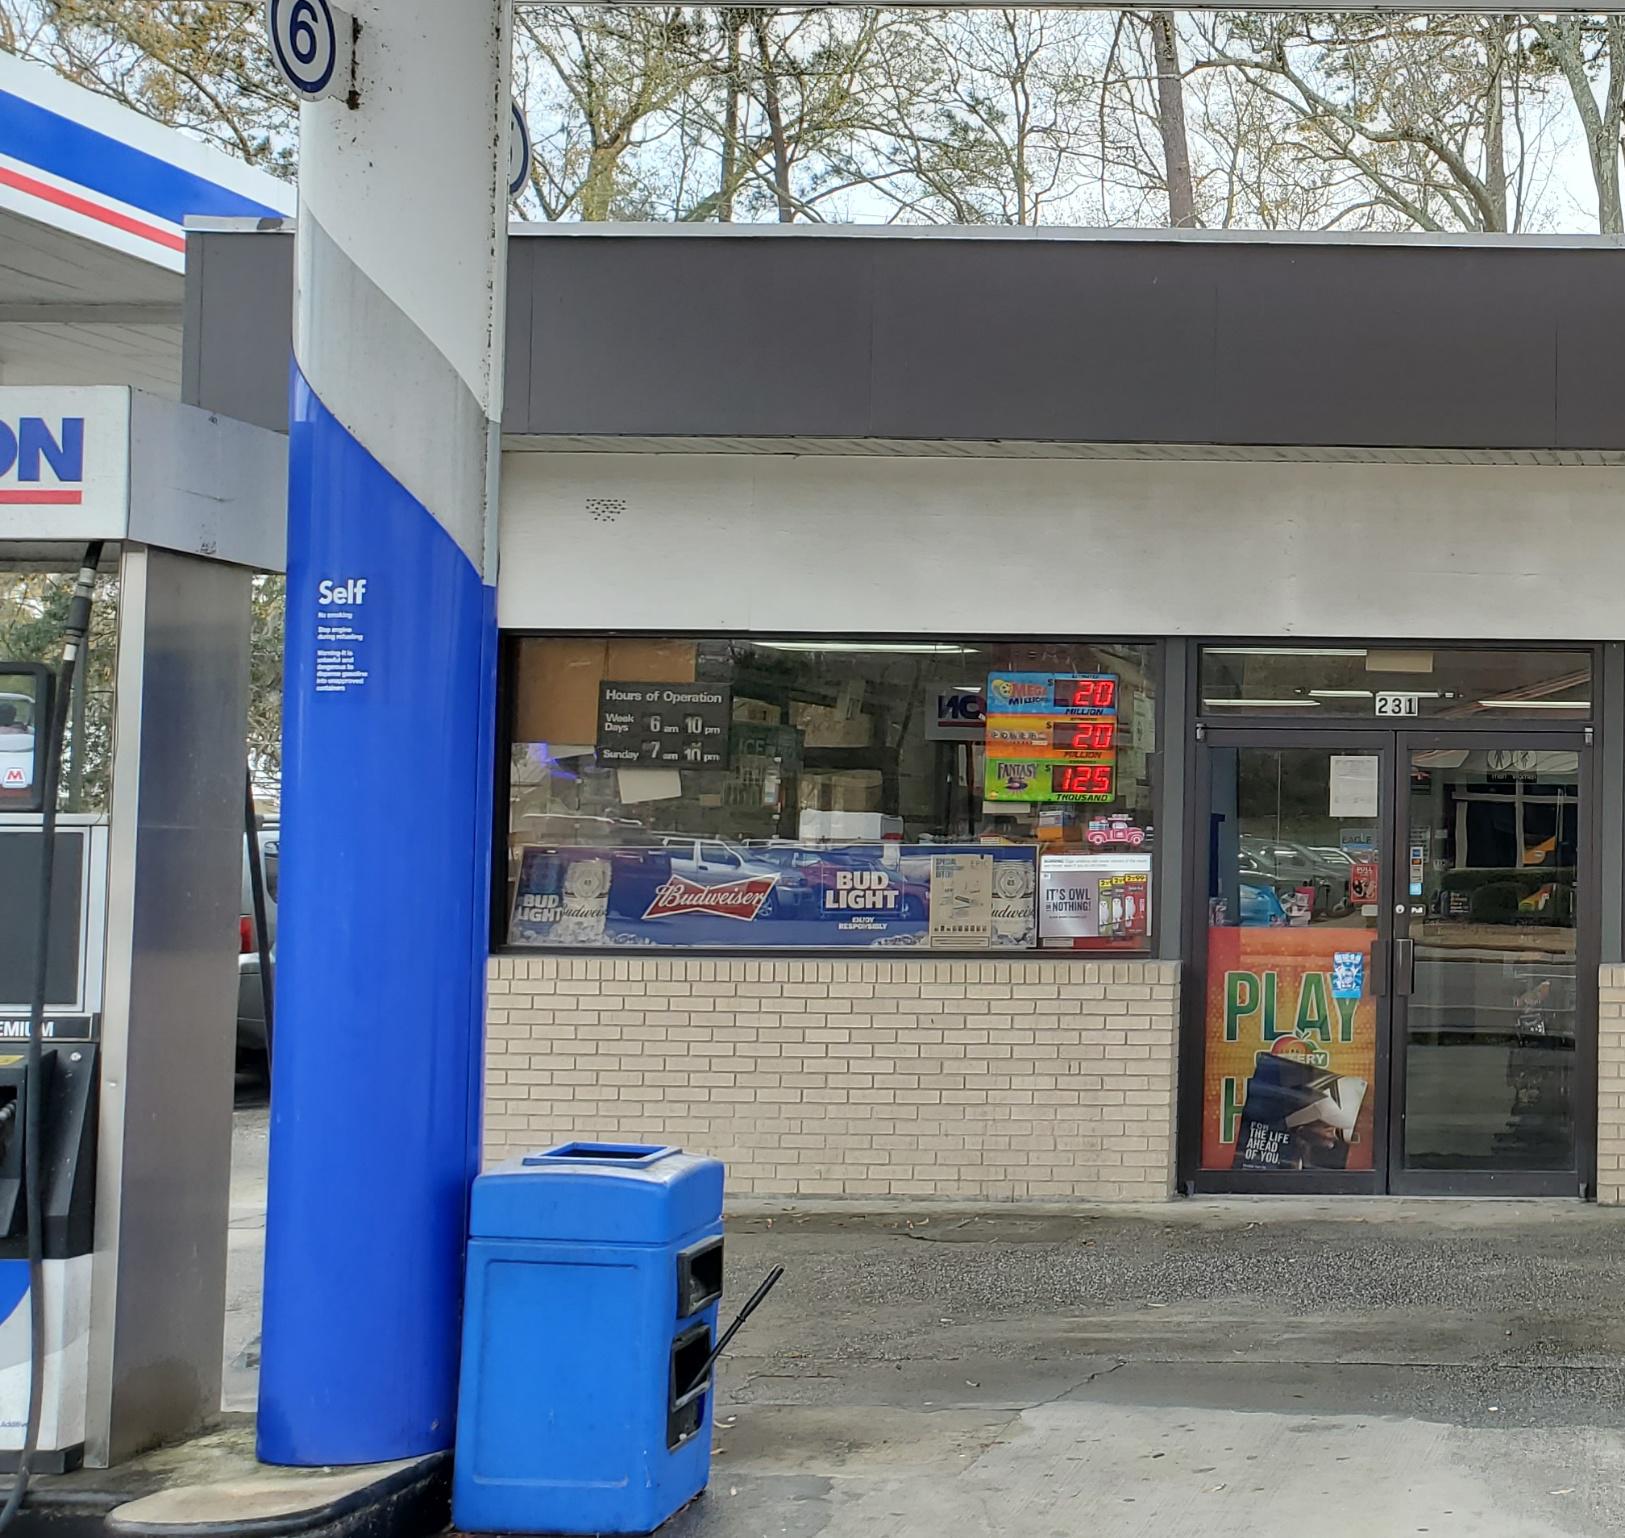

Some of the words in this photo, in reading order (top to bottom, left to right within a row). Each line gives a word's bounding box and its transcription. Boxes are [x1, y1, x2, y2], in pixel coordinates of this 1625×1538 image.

[290, 0, 318, 64] 6
[319, 579, 366, 604] Self
[605, 689, 642, 701] Hours
[646, 691, 660, 701] of
[663, 691, 723, 704] Operation
[1073, 681, 1115, 706] 20
[1065, 708, 1105, 716] MILLION
[1378, 697, 1416, 714] 231
[604, 723, 629, 734] Days
[605, 713, 634, 723] Week
[650, 716, 661, 732] 6
[663, 725, 680, 733] am
[684, 716, 703, 734] 10
[704, 726, 721, 735] pm
[1072, 723, 1113, 748] 20
[602, 749, 640, 761] Sunday
[650, 741, 661, 758] 7
[662, 753, 679, 761] am
[703, 753, 721, 762] pm
[1063, 751, 1102, 759] MILLION
[997, 763, 1039, 779] FANTASY
[1062, 767, 1111, 791] 125
[1056, 793, 1108, 801] THOUSAND
[1356, 866, 1373, 874] PULL
[836, 871, 889, 890] BUD
[523, 893, 560, 908] BUD
[655, 884, 765, 908] Budweiser
[825, 890, 899, 910] LIGHT
[1046, 888, 1066, 901] IT'S
[1068, 888, 1091, 901] OWL
[517, 906, 563, 923] LIGHT
[1052, 902, 1091, 912] NOTHING!
[1411, 905, 1423, 914] Pull
[1225, 971, 1365, 1043] PLAY
[1250, 1121, 1269, 1132] FOR
[1249, 1128, 1267, 1140] THE
[1269, 1131, 1290, 1144] LIFE
[1246, 1138, 1278, 1152] AHEAD
[1245, 1149, 1258, 1160] OF
[1260, 1150, 1281, 1165] YOU.
